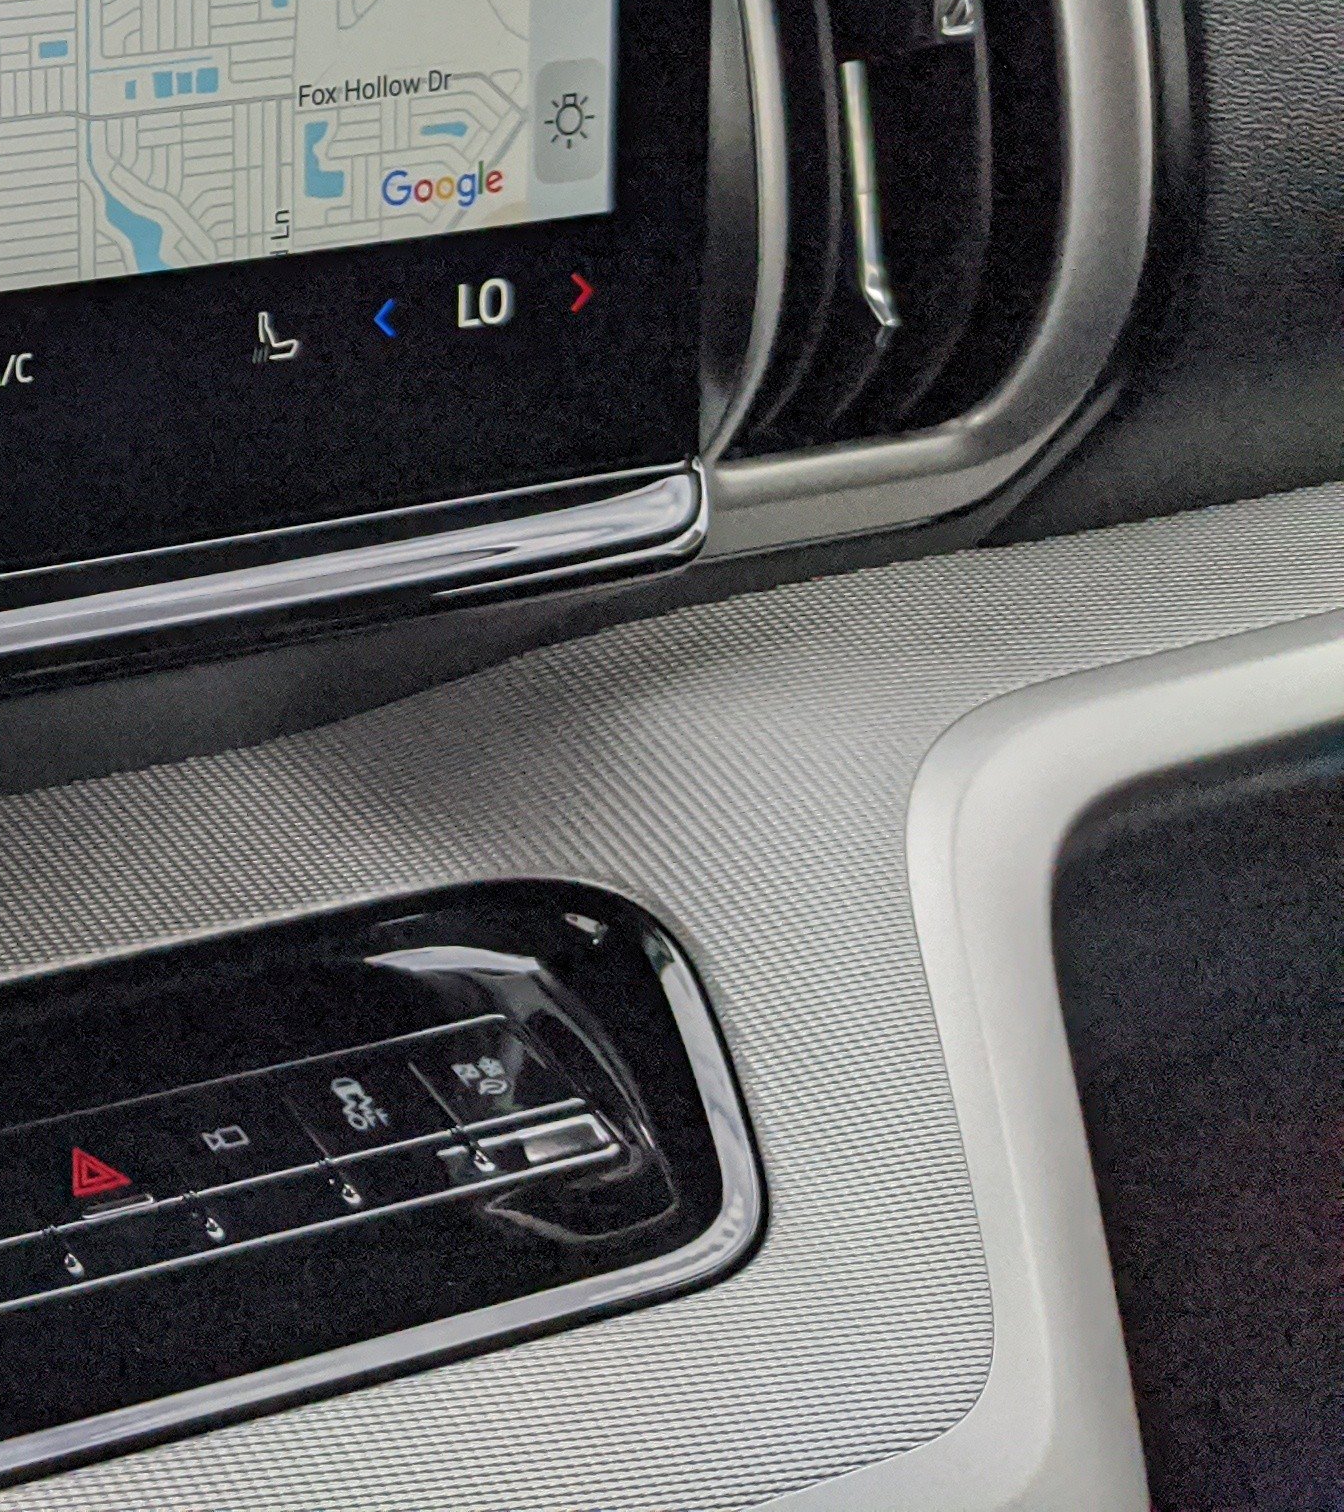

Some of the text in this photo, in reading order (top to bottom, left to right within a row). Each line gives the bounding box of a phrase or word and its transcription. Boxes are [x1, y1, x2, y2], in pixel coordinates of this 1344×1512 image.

[298, 69, 453, 108] Fox Hollow Dr
[381, 160, 504, 207] Google
[270, 209, 290, 240] Ln
[457, 277, 510, 329] LO
